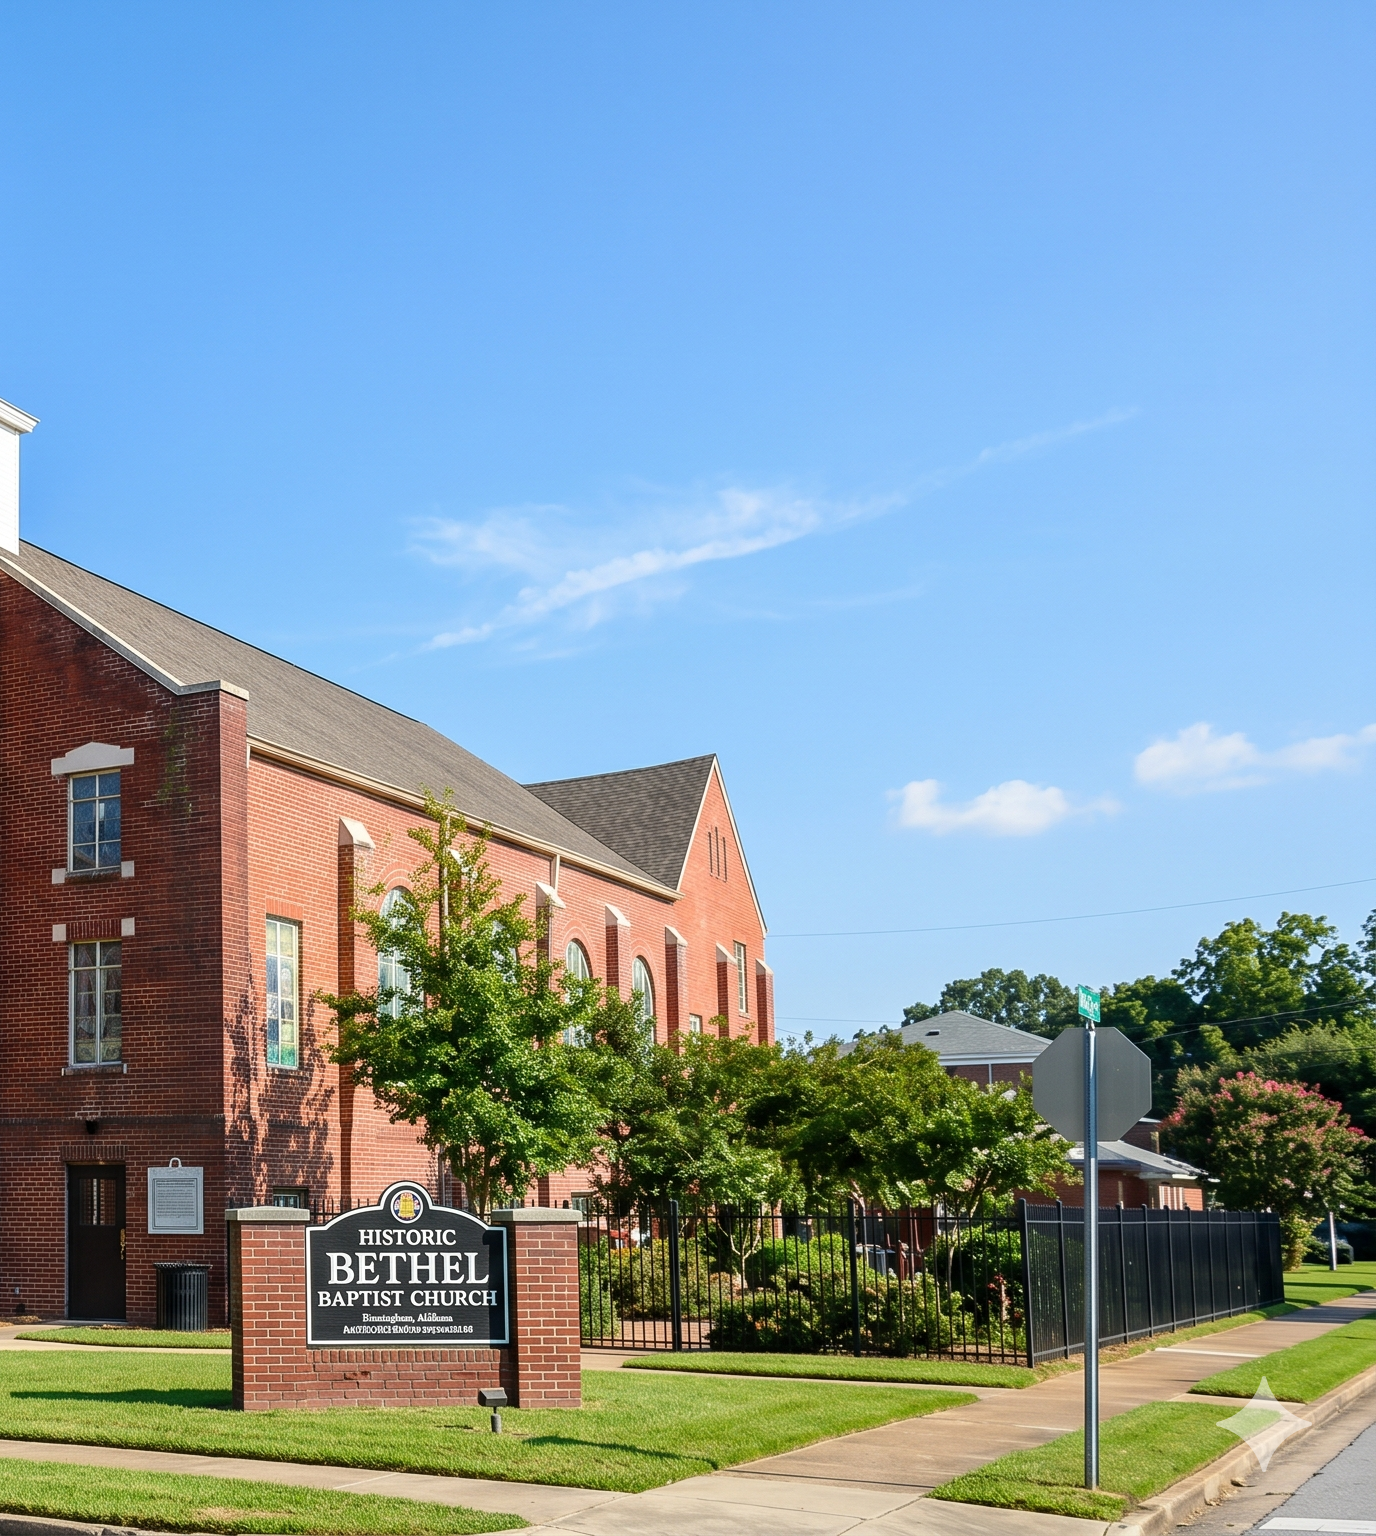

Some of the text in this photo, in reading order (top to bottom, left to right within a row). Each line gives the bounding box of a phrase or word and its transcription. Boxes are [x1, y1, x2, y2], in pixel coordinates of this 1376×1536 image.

[358, 1229, 457, 1246] HISTORIC
[326, 1252, 490, 1285] BETHEL
[317, 1290, 498, 1307] BAPTIST CHURCH
